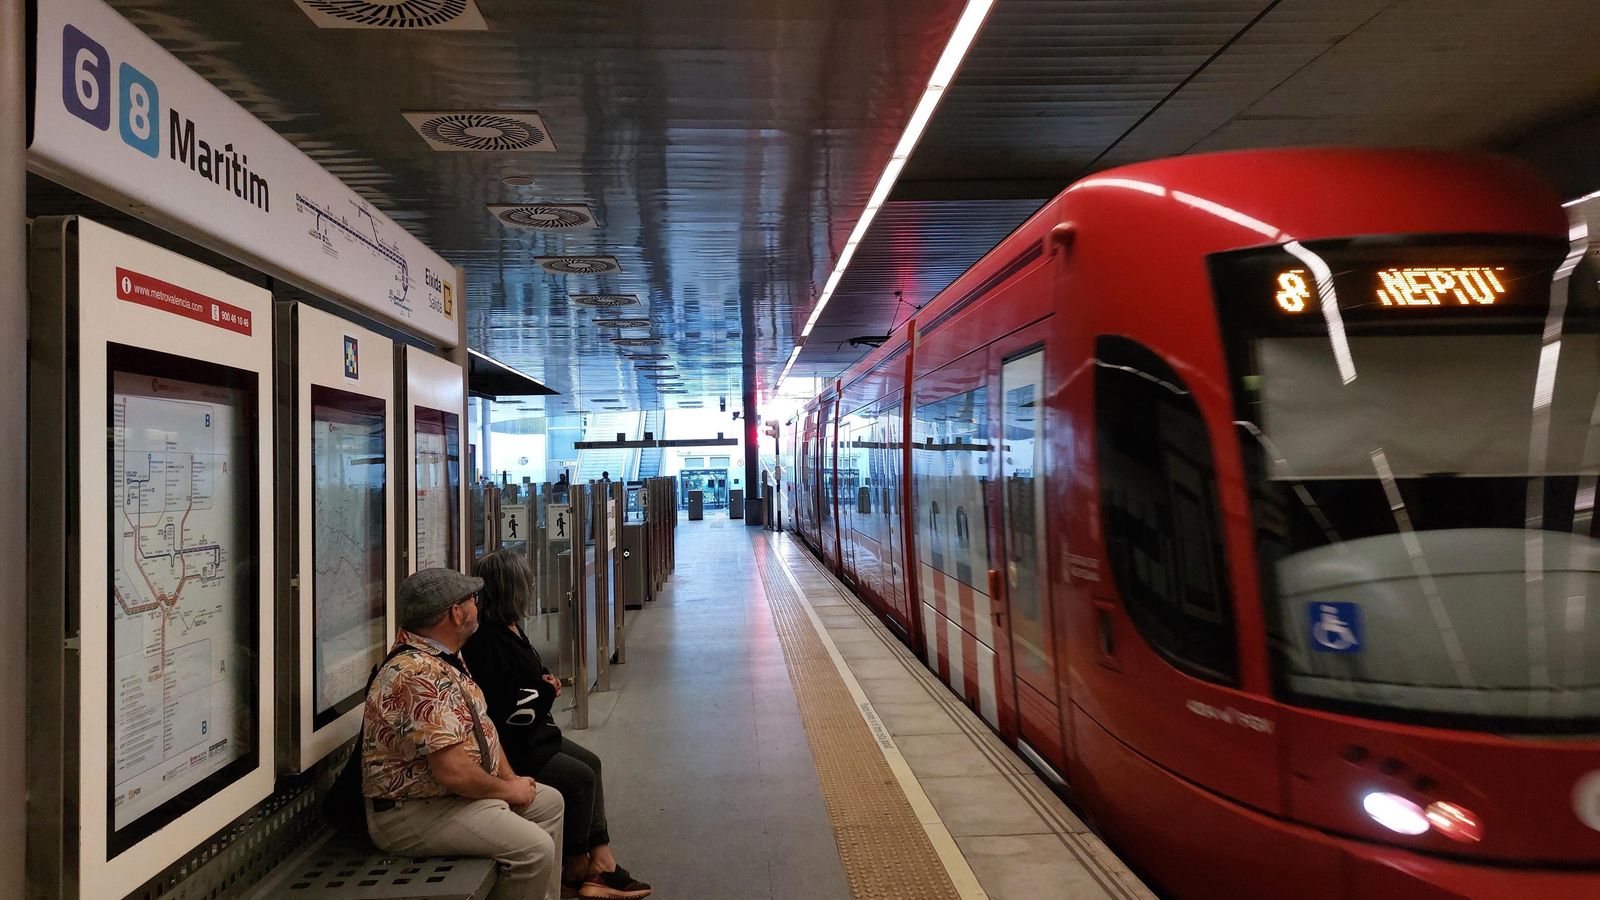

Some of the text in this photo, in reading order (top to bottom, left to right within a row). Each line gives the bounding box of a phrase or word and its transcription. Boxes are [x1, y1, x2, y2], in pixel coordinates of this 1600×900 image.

[74, 47, 270, 213] 6 8 Marítim
[425, 266, 442, 293] Eixida
[1276, 269, 1310, 311] 8
[134, 285, 203, 313] www.metrovalencia.com
[221, 310, 231, 321] 900
[429, 293, 443, 314] Salida
[205, 414, 211, 427] B
[219, 660, 225, 673] A
[201, 720, 207, 735] B
